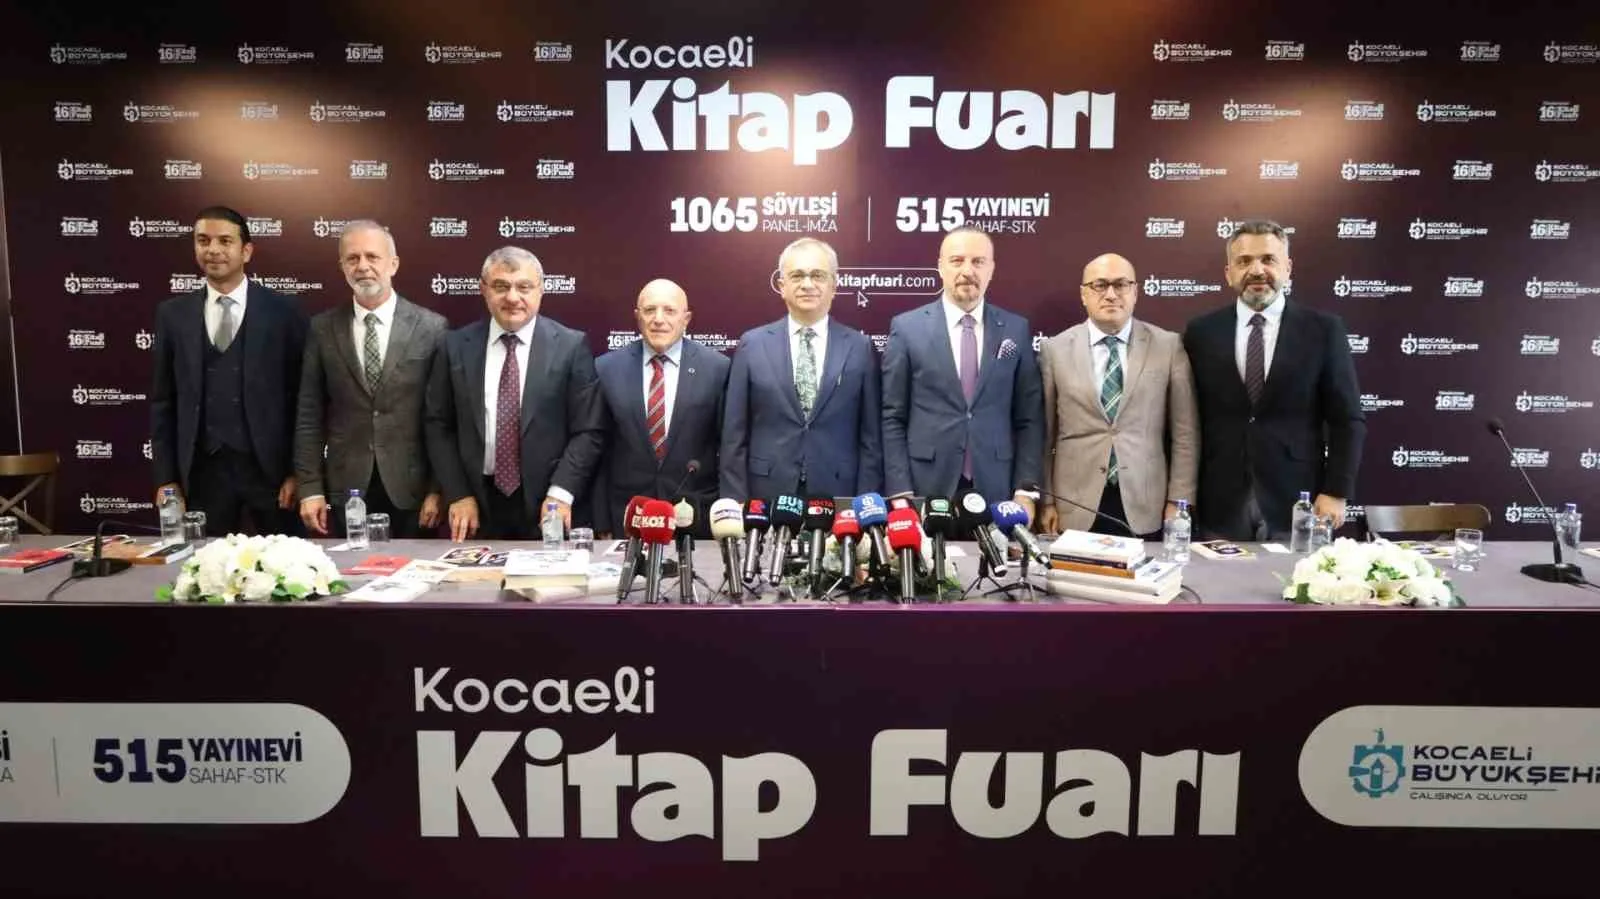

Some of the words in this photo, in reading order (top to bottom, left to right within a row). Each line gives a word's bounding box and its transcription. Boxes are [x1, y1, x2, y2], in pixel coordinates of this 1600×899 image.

[159, 48, 173, 60] 16
[346, 47, 360, 59] 16
[534, 46, 548, 58] 16
[605, 36, 754, 69] Kocaeli
[1265, 45, 1280, 57] 16
[1460, 46, 1475, 58] 16
[54, 106, 68, 118] 16
[241, 106, 255, 118] 16
[427, 106, 442, 118] 16
[1151, 104, 1166, 116] 16
[1345, 105, 1360, 117] 16
[1540, 106, 1555, 118] 16
[606, 77, 854, 165] Kitap
[885, 76, 1116, 150] Fuarı
[165, 164, 179, 176] 16
[350, 164, 364, 176] 16
[536, 164, 550, 176] 16
[1259, 164, 1274, 176] 16
[1453, 165, 1468, 177] 16
[670, 197, 759, 233] 1065
[762, 192, 838, 220] SÖYLEŞİ
[896, 197, 965, 233] 515
[966, 193, 1050, 217] YAYINEVİ
[61, 221, 75, 233] 16
[430, 222, 444, 234] 16
[762, 217, 838, 233] PANEL-İMZA
[1146, 222, 1160, 234] 16
[1338, 223, 1352, 235] 16
[1530, 224, 1545, 236] 16
[170, 278, 184, 290] 16
[544, 278, 552, 290] 6
[836, 273, 936, 290] kitapfuari.com
[1444, 281, 1459, 293] 16
[68, 334, 82, 346] 16
[607, 335, 621, 346] 16
[1521, 339, 1536, 351] 16
[1436, 395, 1450, 407] 16
[76, 444, 90, 456] 16
[414, 666, 656, 714] Kocaeli
[93, 738, 188, 784] 515
[188, 731, 303, 762] YAYINEVİ
[189, 767, 287, 785] SAHAF-STK
[416, 728, 817, 861] Kitap
[870, 728, 1242, 839] Fuarı
